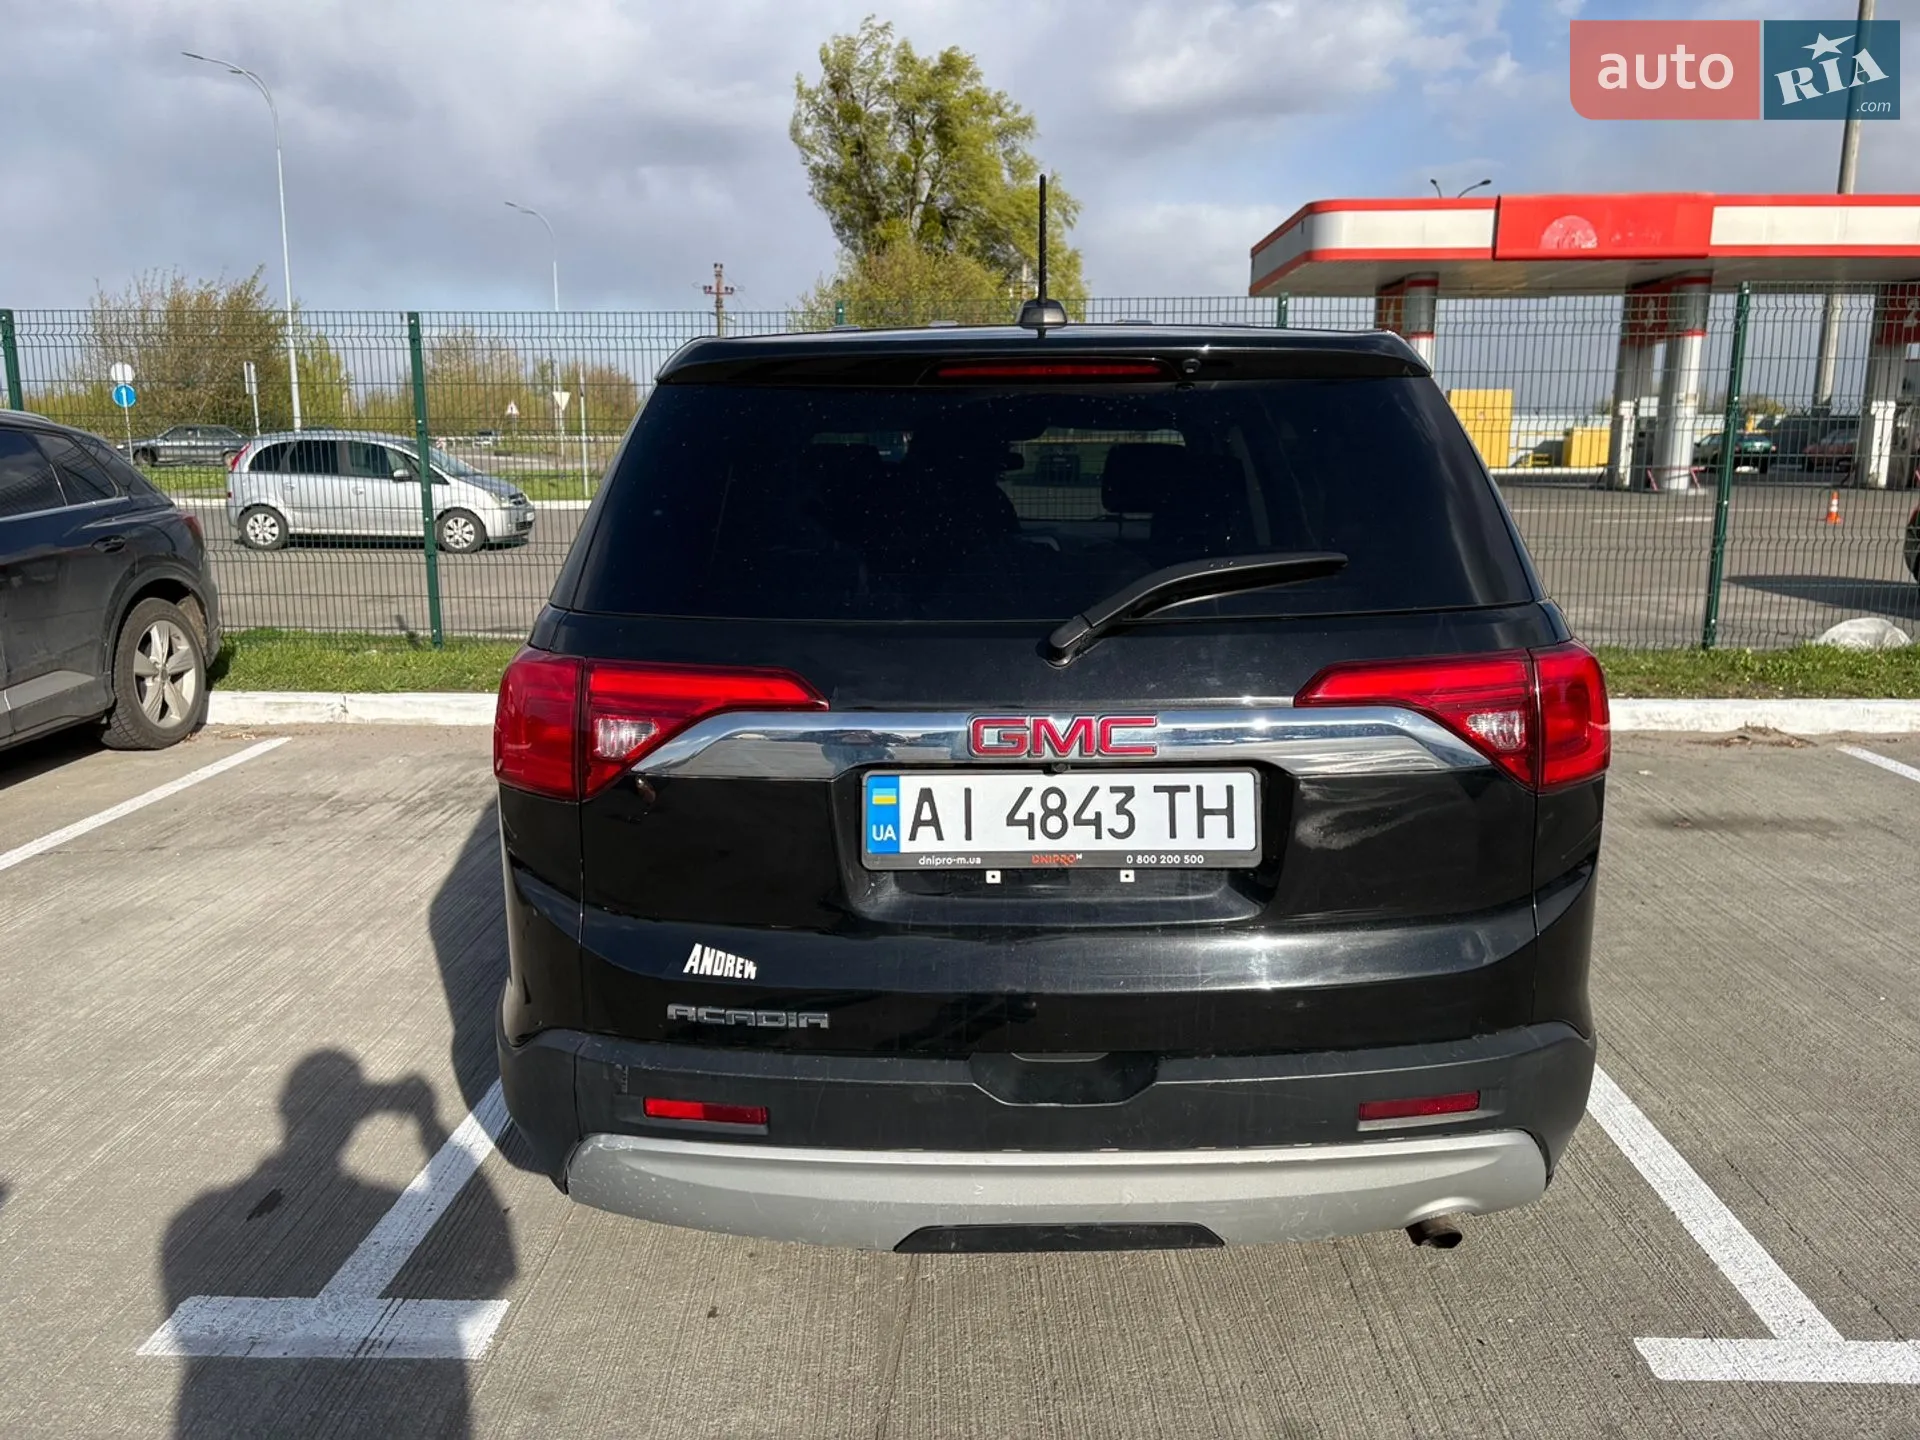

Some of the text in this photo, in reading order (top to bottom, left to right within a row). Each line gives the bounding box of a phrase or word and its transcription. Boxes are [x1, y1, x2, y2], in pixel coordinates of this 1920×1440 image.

[968, 715, 1158, 757] GMC
[908, 784, 1235, 841] AI 4843 TH
[872, 824, 896, 841] UA
[918, 855, 982, 866] dnipro-m.ua
[1126, 855, 1133, 864] 0
[1136, 855, 1157, 864] 800
[1160, 855, 1181, 864] 200
[1184, 855, 1205, 864] 500
[683, 943, 757, 980] ANDREW
[667, 1003, 829, 1029] ACADIA
